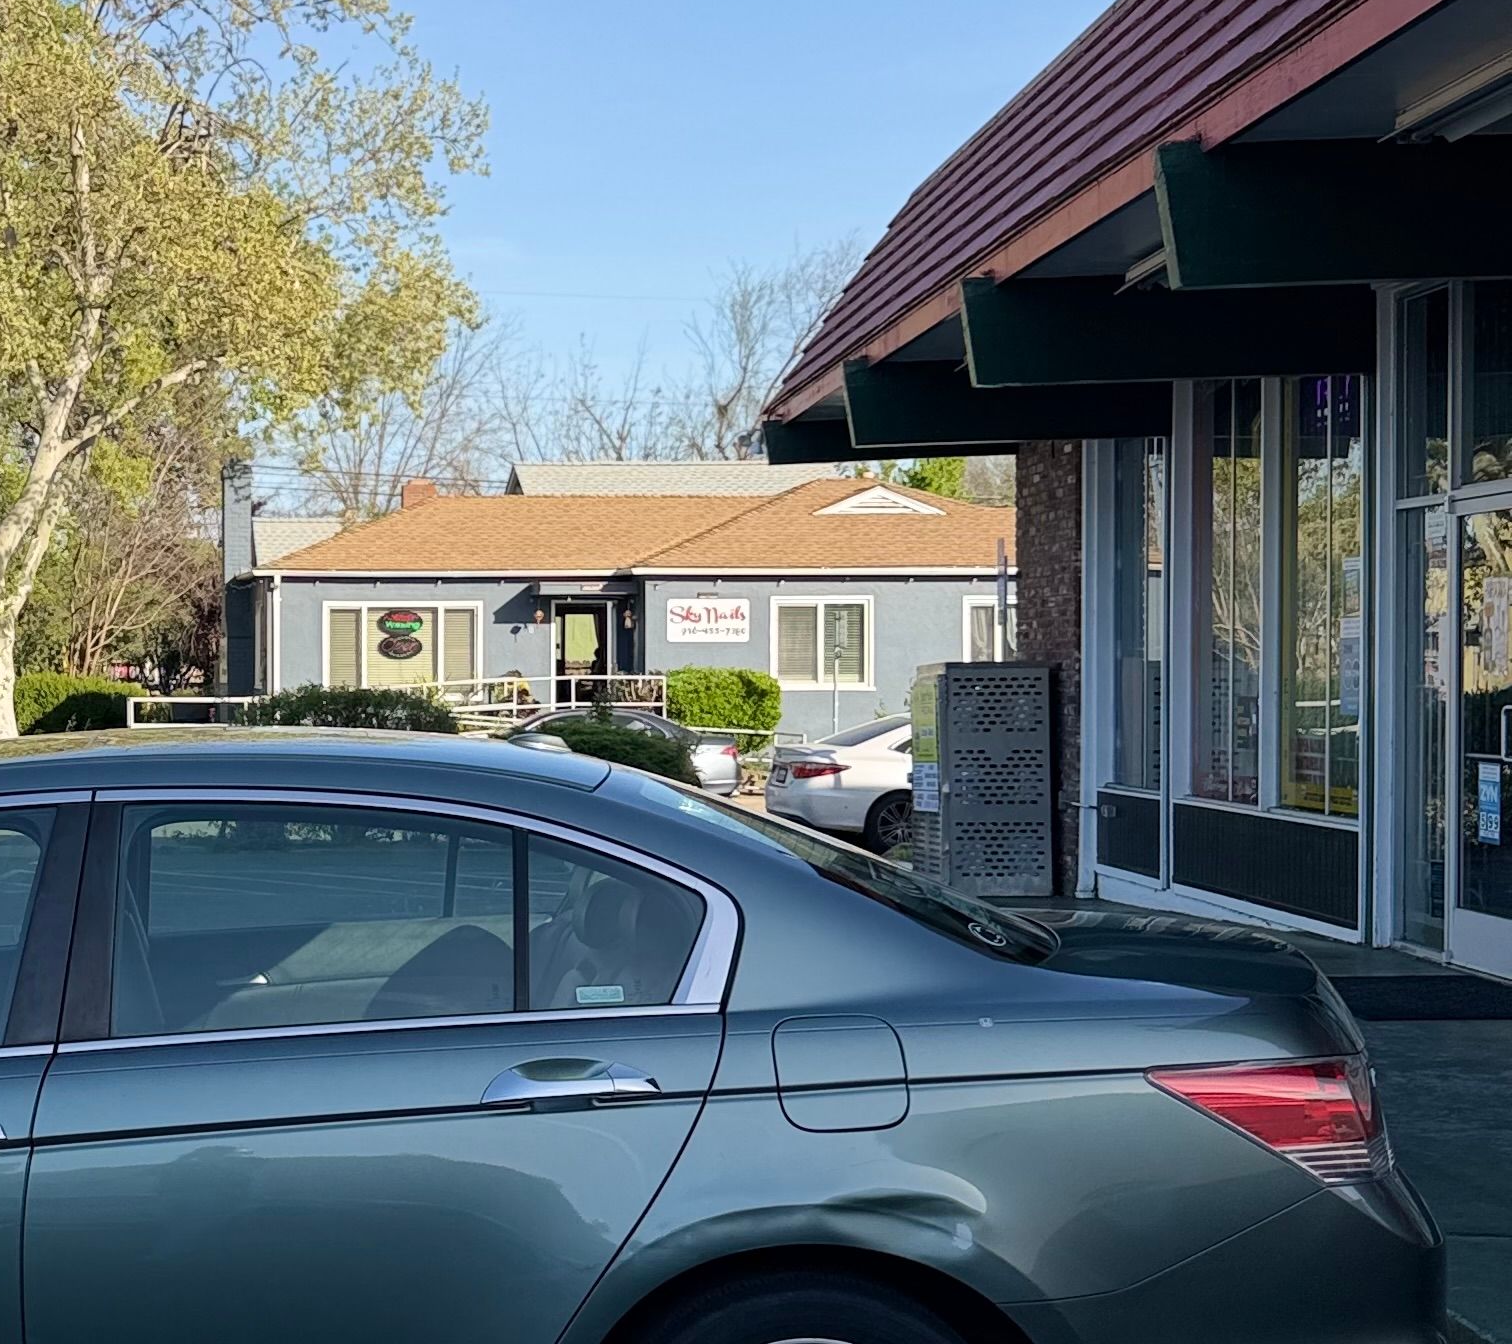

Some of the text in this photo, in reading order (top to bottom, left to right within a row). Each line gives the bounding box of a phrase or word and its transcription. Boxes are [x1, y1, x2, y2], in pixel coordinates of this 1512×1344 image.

[669, 605, 746, 624] Sky Nails
[1480, 784, 1498, 803] ZYN
